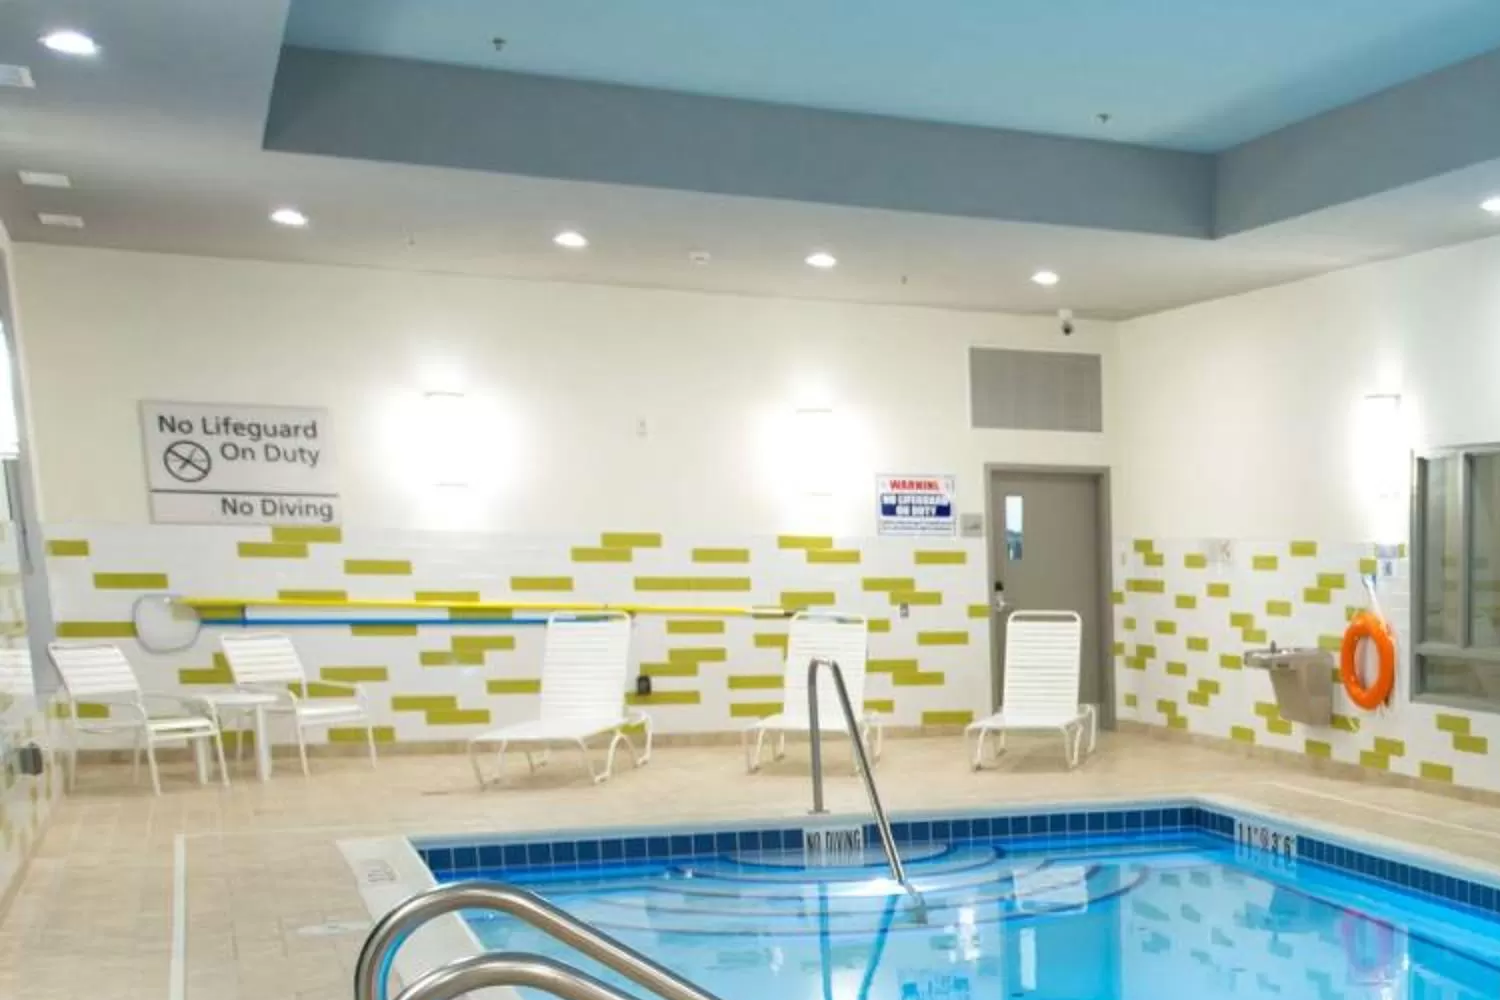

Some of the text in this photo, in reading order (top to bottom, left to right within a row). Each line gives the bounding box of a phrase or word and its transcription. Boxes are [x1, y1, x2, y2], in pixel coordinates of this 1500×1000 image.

[157, 415, 318, 441] No Lifeguard
[219, 442, 320, 467] On Duty
[220, 497, 333, 522] No Diving
